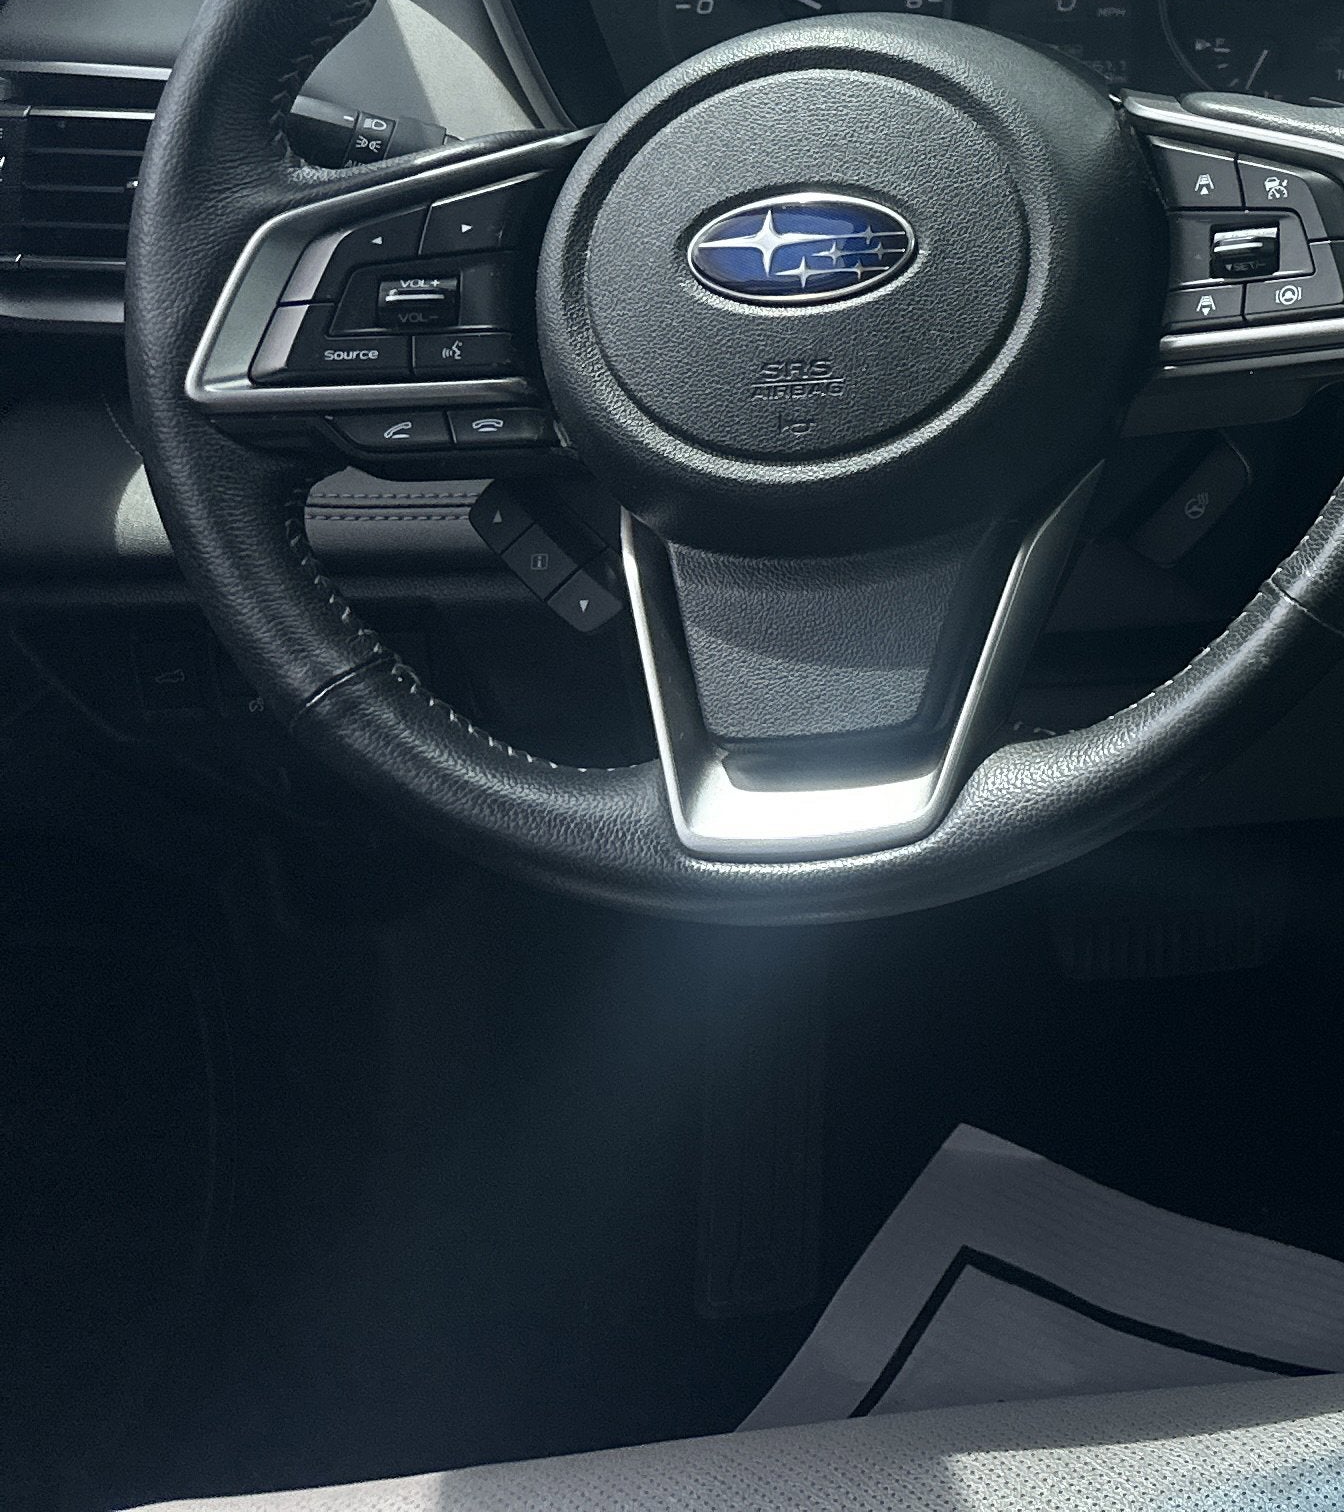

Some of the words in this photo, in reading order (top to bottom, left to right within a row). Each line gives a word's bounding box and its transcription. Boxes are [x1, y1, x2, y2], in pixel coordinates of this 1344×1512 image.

[324, 349, 379, 361] Source
[761, 361, 834, 382] SRS
[749, 383, 844, 401] AIRBAG
